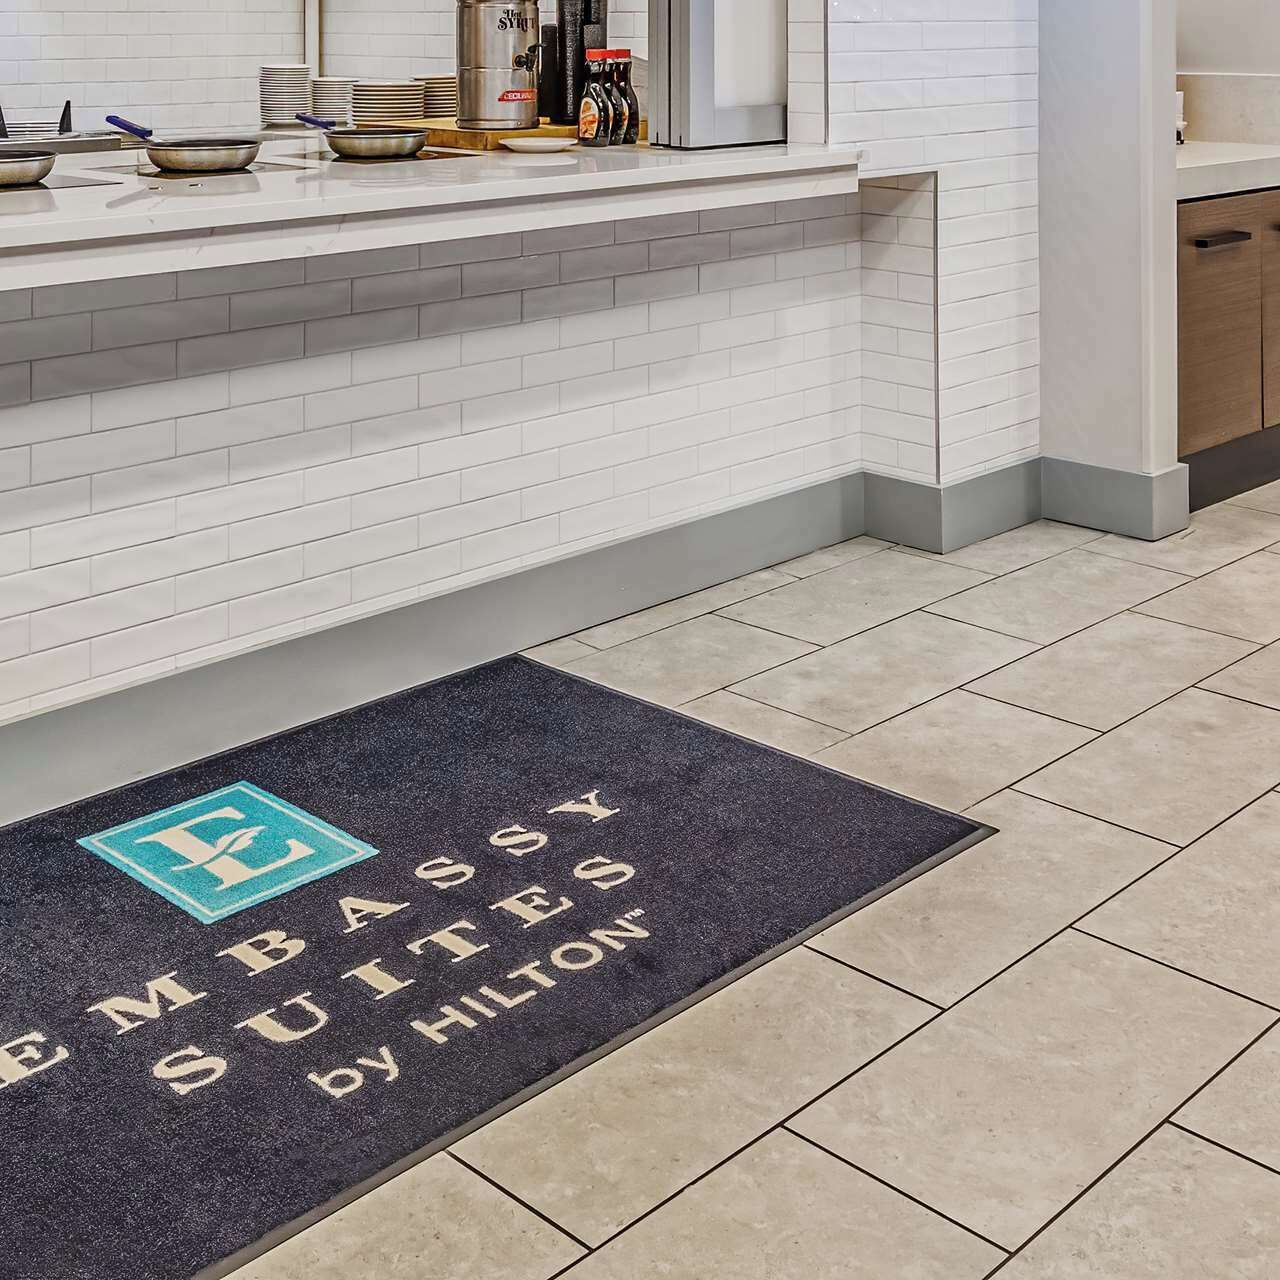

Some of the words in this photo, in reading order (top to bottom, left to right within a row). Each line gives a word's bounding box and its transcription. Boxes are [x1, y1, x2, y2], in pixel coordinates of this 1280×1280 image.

[502, 8, 522, 18] Hot
[134, 806, 316, 892] E
[152, 855, 636, 1096] SUITES
[306, 1045, 400, 1100] by
